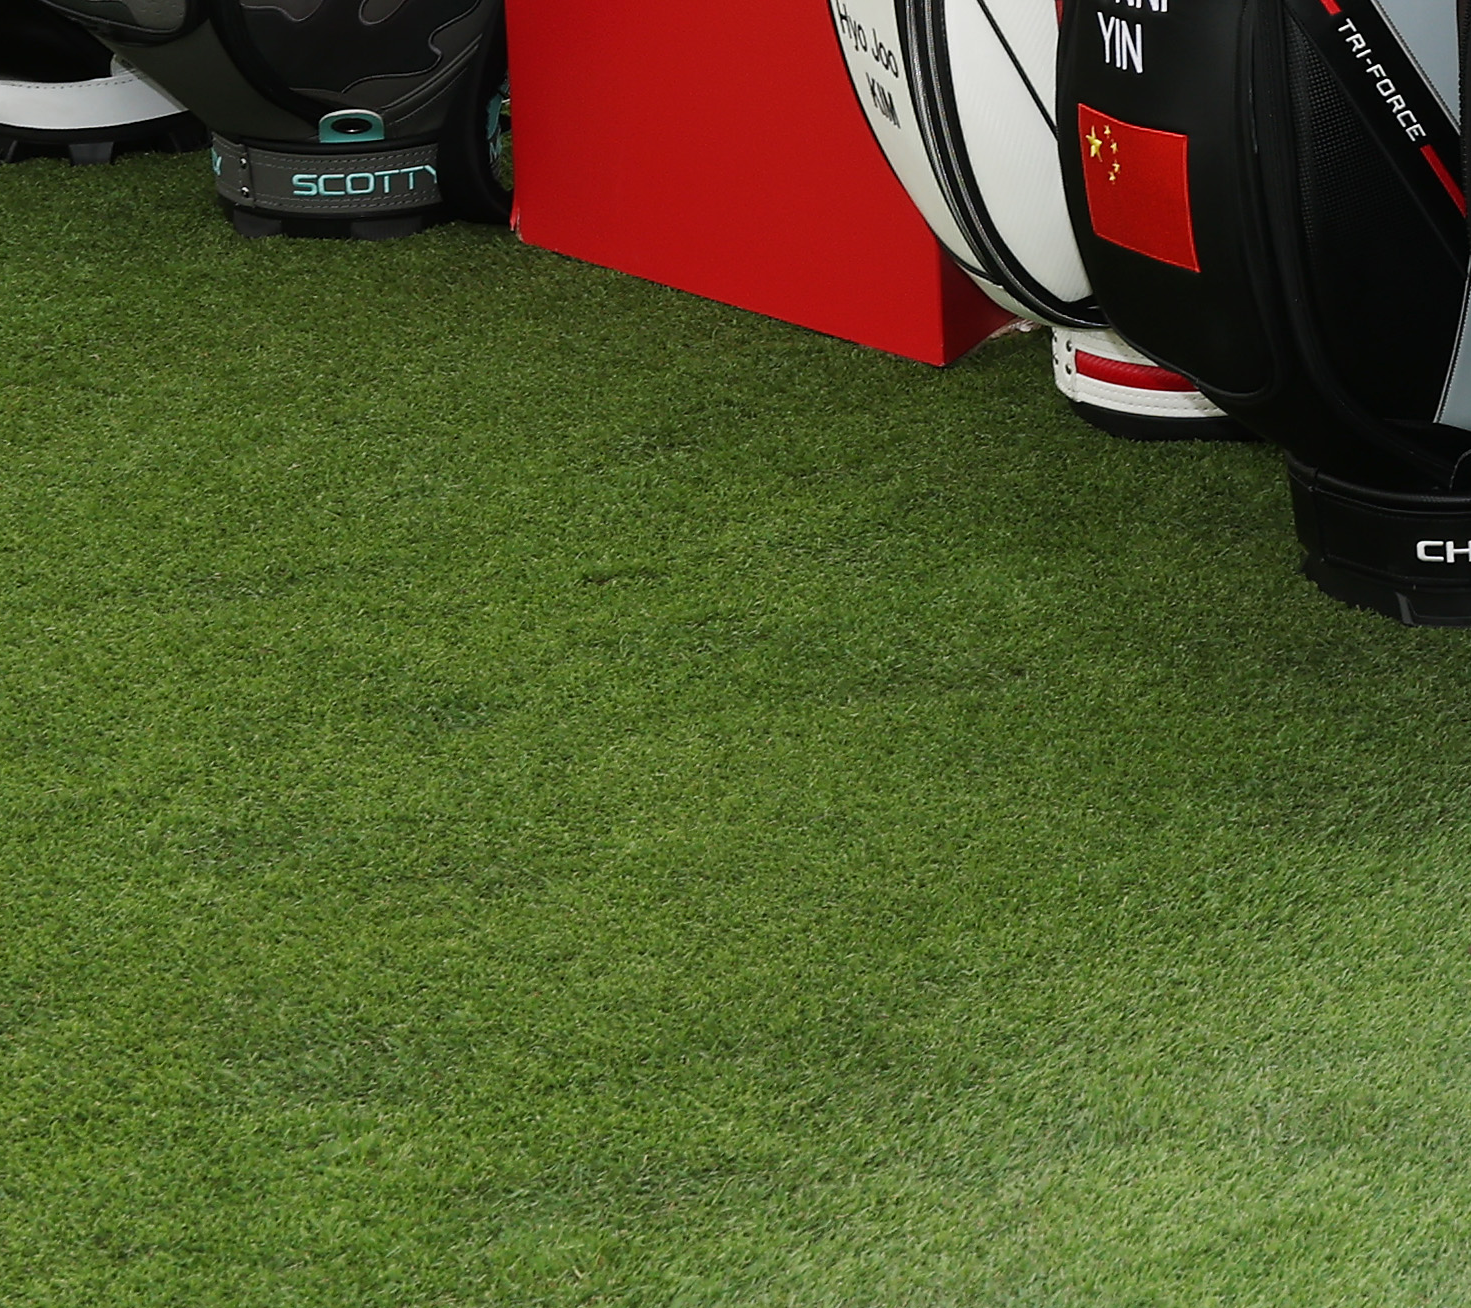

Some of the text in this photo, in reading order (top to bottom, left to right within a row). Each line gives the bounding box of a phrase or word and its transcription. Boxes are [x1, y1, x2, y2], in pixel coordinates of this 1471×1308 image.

[870, 28, 900, 78] Joo
[1096, 12, 1144, 74] YIN
[869, 71, 901, 129] KIM
[1338, 18, 1428, 143] TRI-FORCE
